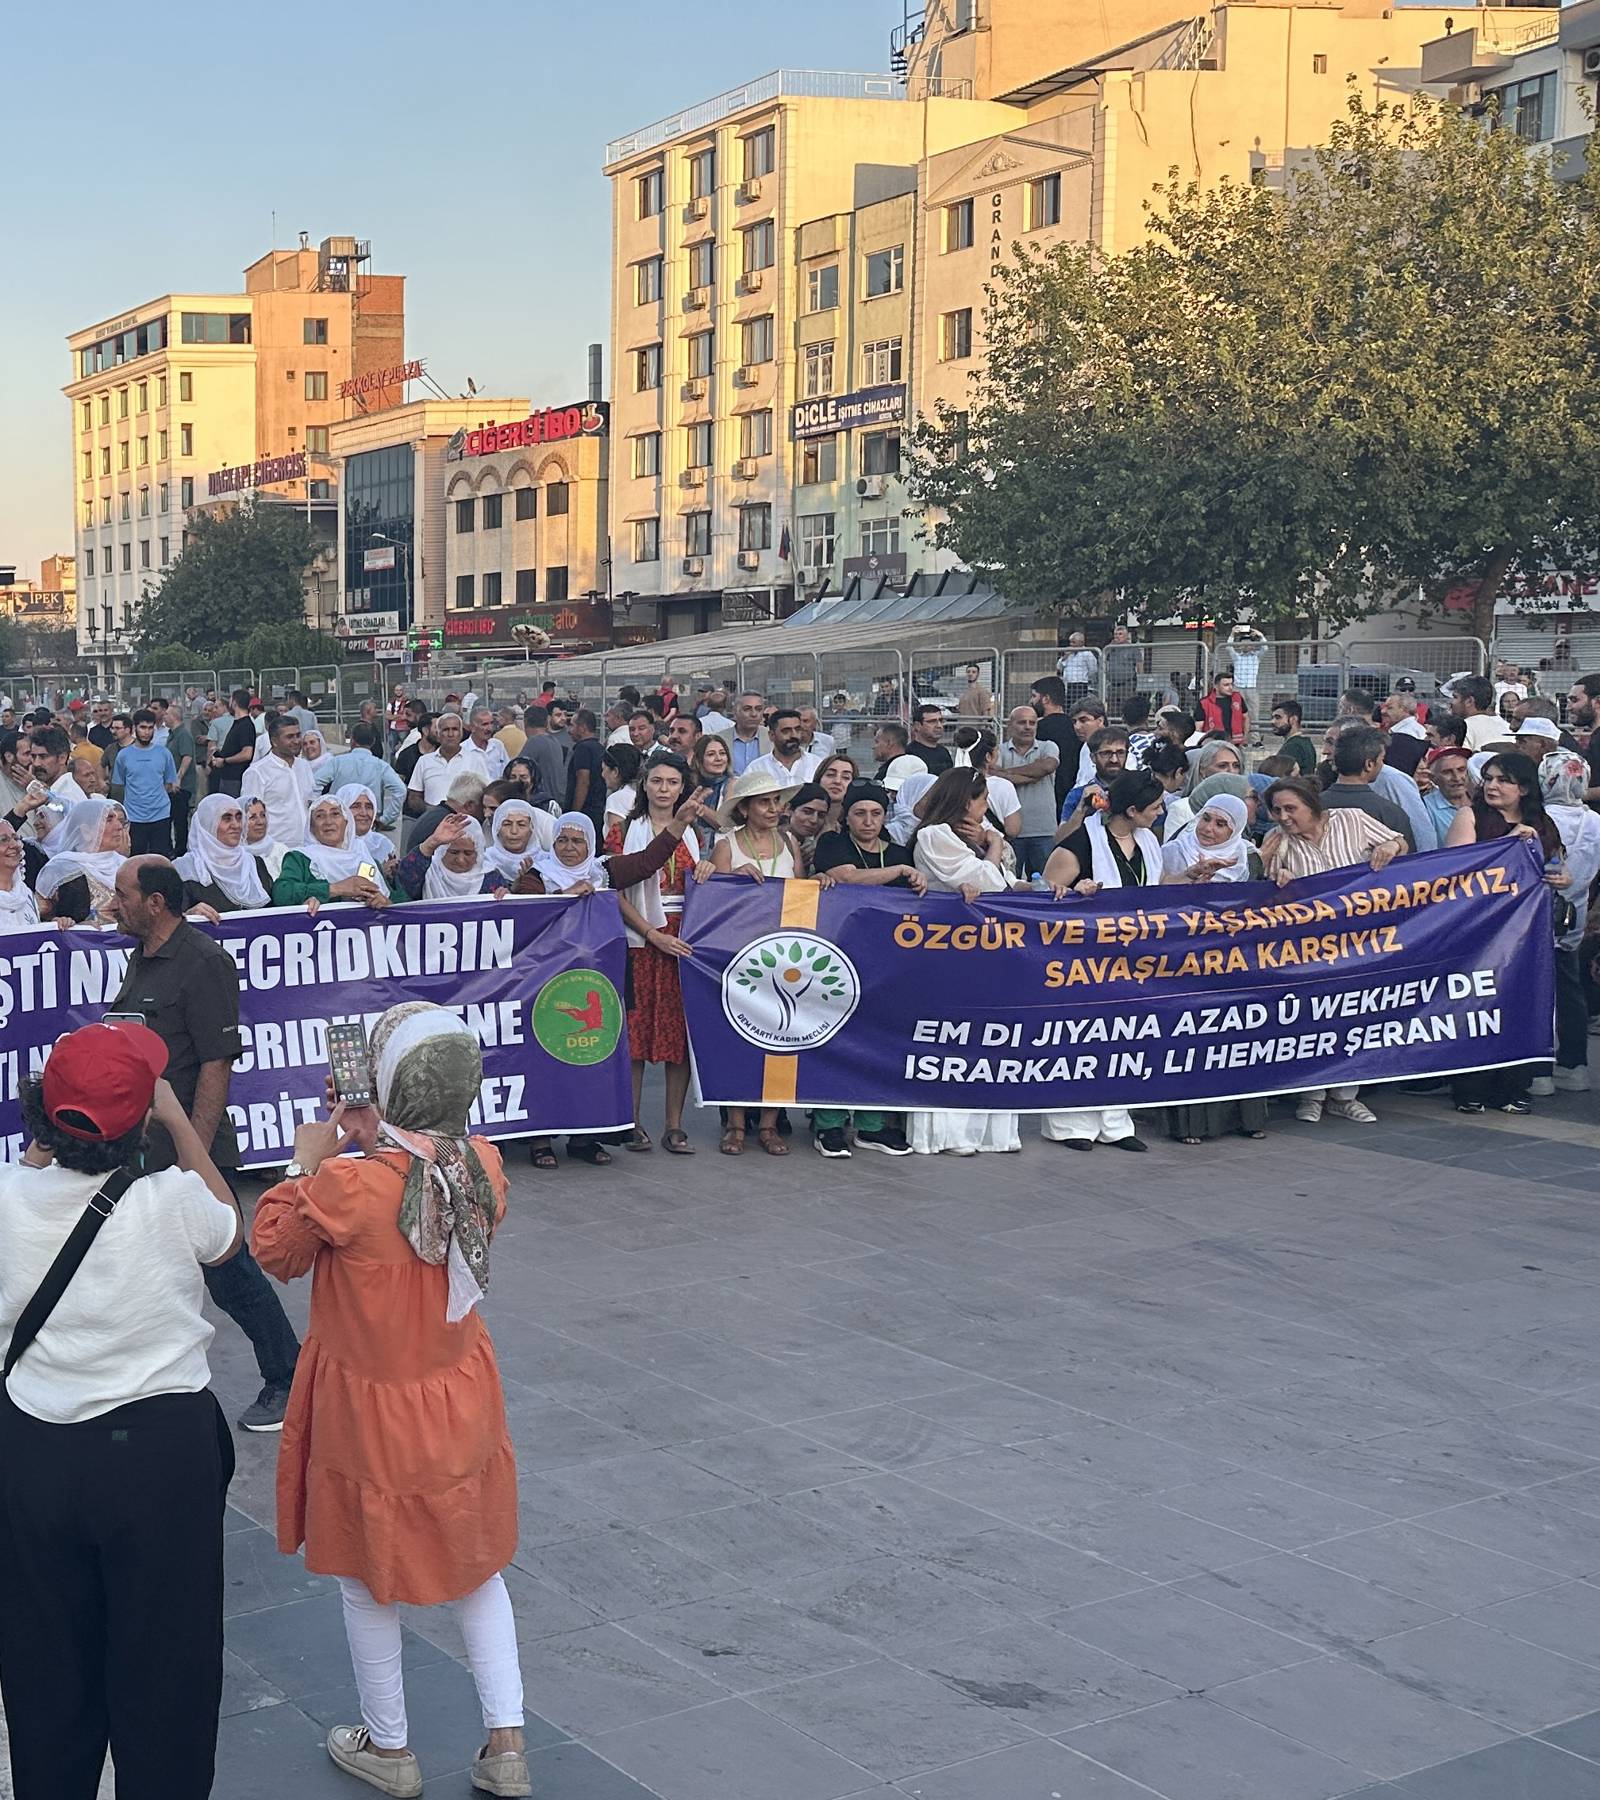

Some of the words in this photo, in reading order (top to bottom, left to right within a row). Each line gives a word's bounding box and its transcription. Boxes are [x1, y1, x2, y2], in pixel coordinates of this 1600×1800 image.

[893, 914, 1026, 951] ÖZGÜR
[1039, 918, 1085, 947] VE
[1096, 909, 1169, 948] EŞİT
[1178, 900, 1337, 938] YAŞAMDA
[1338, 866, 1520, 918] ISRARCIYIZ,
[68, 947, 137, 1006] NA
[1043, 945, 1249, 988] SAVAŞLARA
[1257, 925, 1404, 970] KARŞIYIZ
[737, 1013, 752, 1028] DEM
[912, 1019, 972, 1047] EM
[981, 1022, 1023, 1048] DI
[1030, 1013, 1162, 1047] JIYANA
[1171, 1002, 1268, 1038] AZAD
[1278, 993, 1300, 1026] Û
[1310, 976, 1440, 1022] WEKHEV
[1446, 969, 1498, 1001] DE
[566, 1036, 600, 1049] DBP
[904, 1053, 1099, 1084] ISRARKAR
[1106, 1051, 1153, 1081] IN,
[1163, 1046, 1194, 1075] LI
[1204, 1031, 1338, 1071] HEMBER
[1343, 1014, 1457, 1057] ŞERAN
[1467, 1008, 1502, 1039] IN
